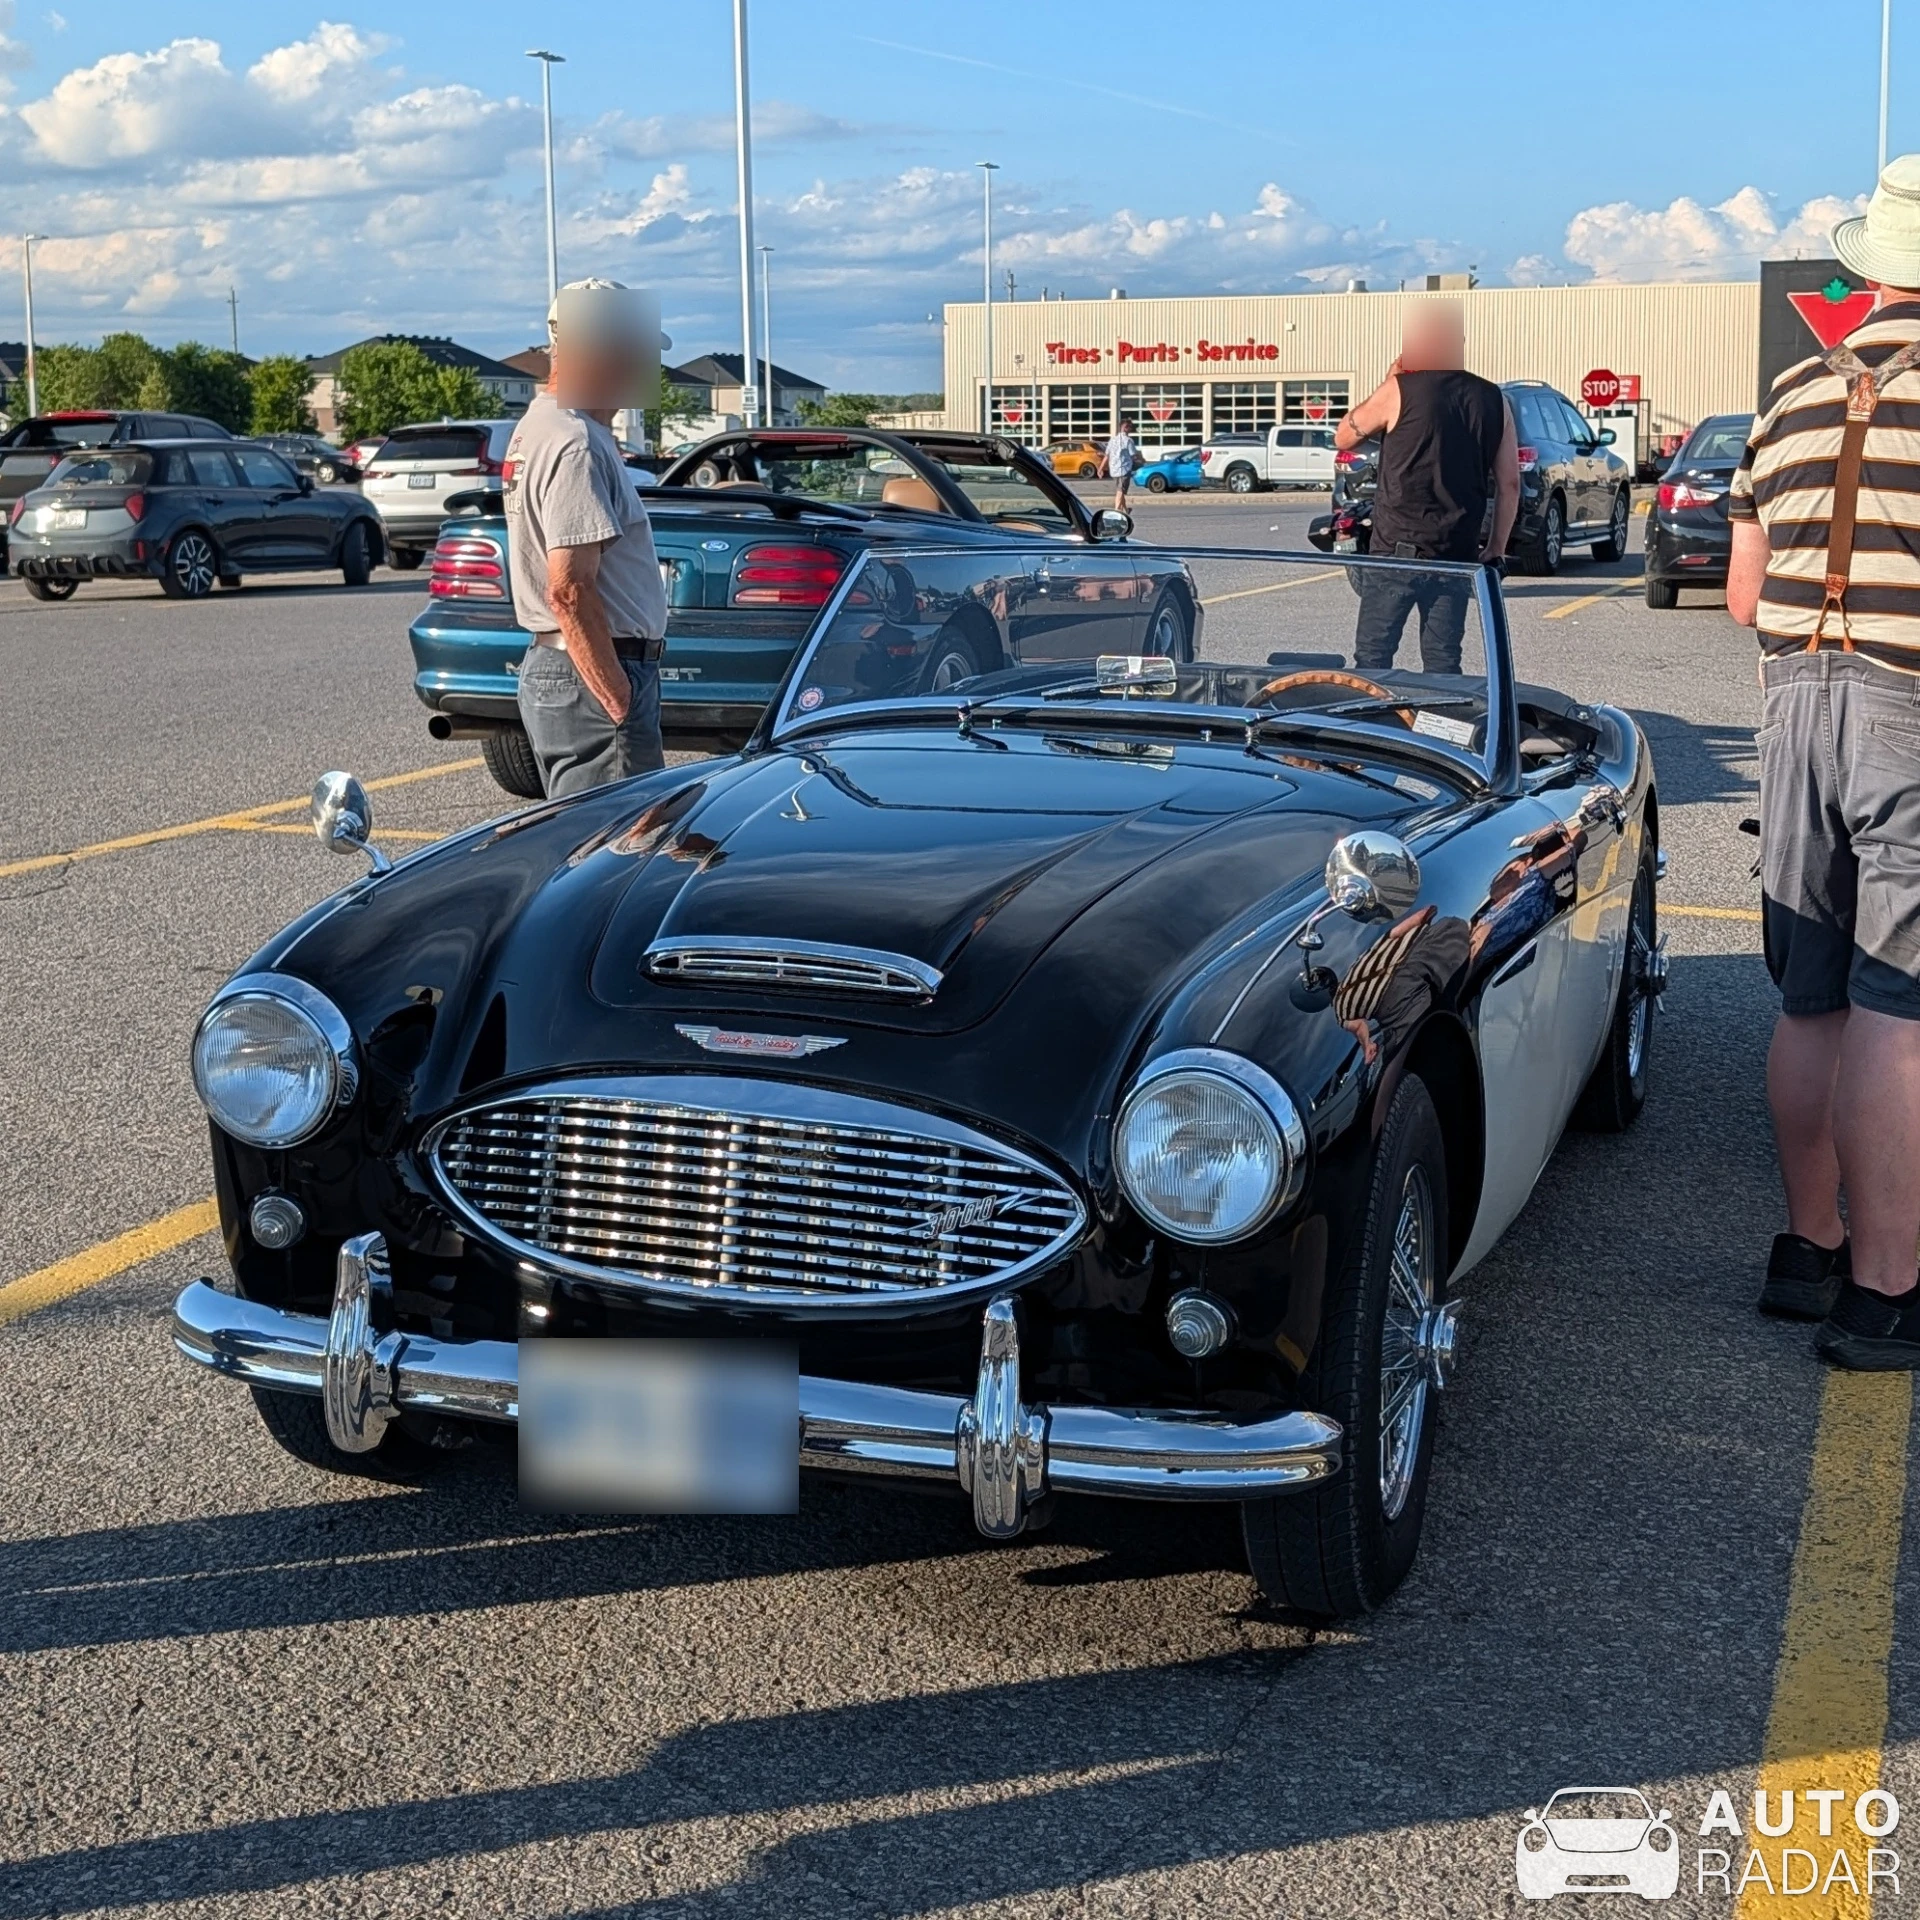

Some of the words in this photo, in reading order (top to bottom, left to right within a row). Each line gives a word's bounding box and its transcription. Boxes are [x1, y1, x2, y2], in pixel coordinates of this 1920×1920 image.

[1046, 342, 1101, 364] Tires
[1118, 341, 1180, 363] Parts
[1197, 338, 1279, 362] Service
[1583, 380, 1618, 397] STOP
[658, 667, 702, 681] GT
[922, 1194, 997, 1239] 3000
